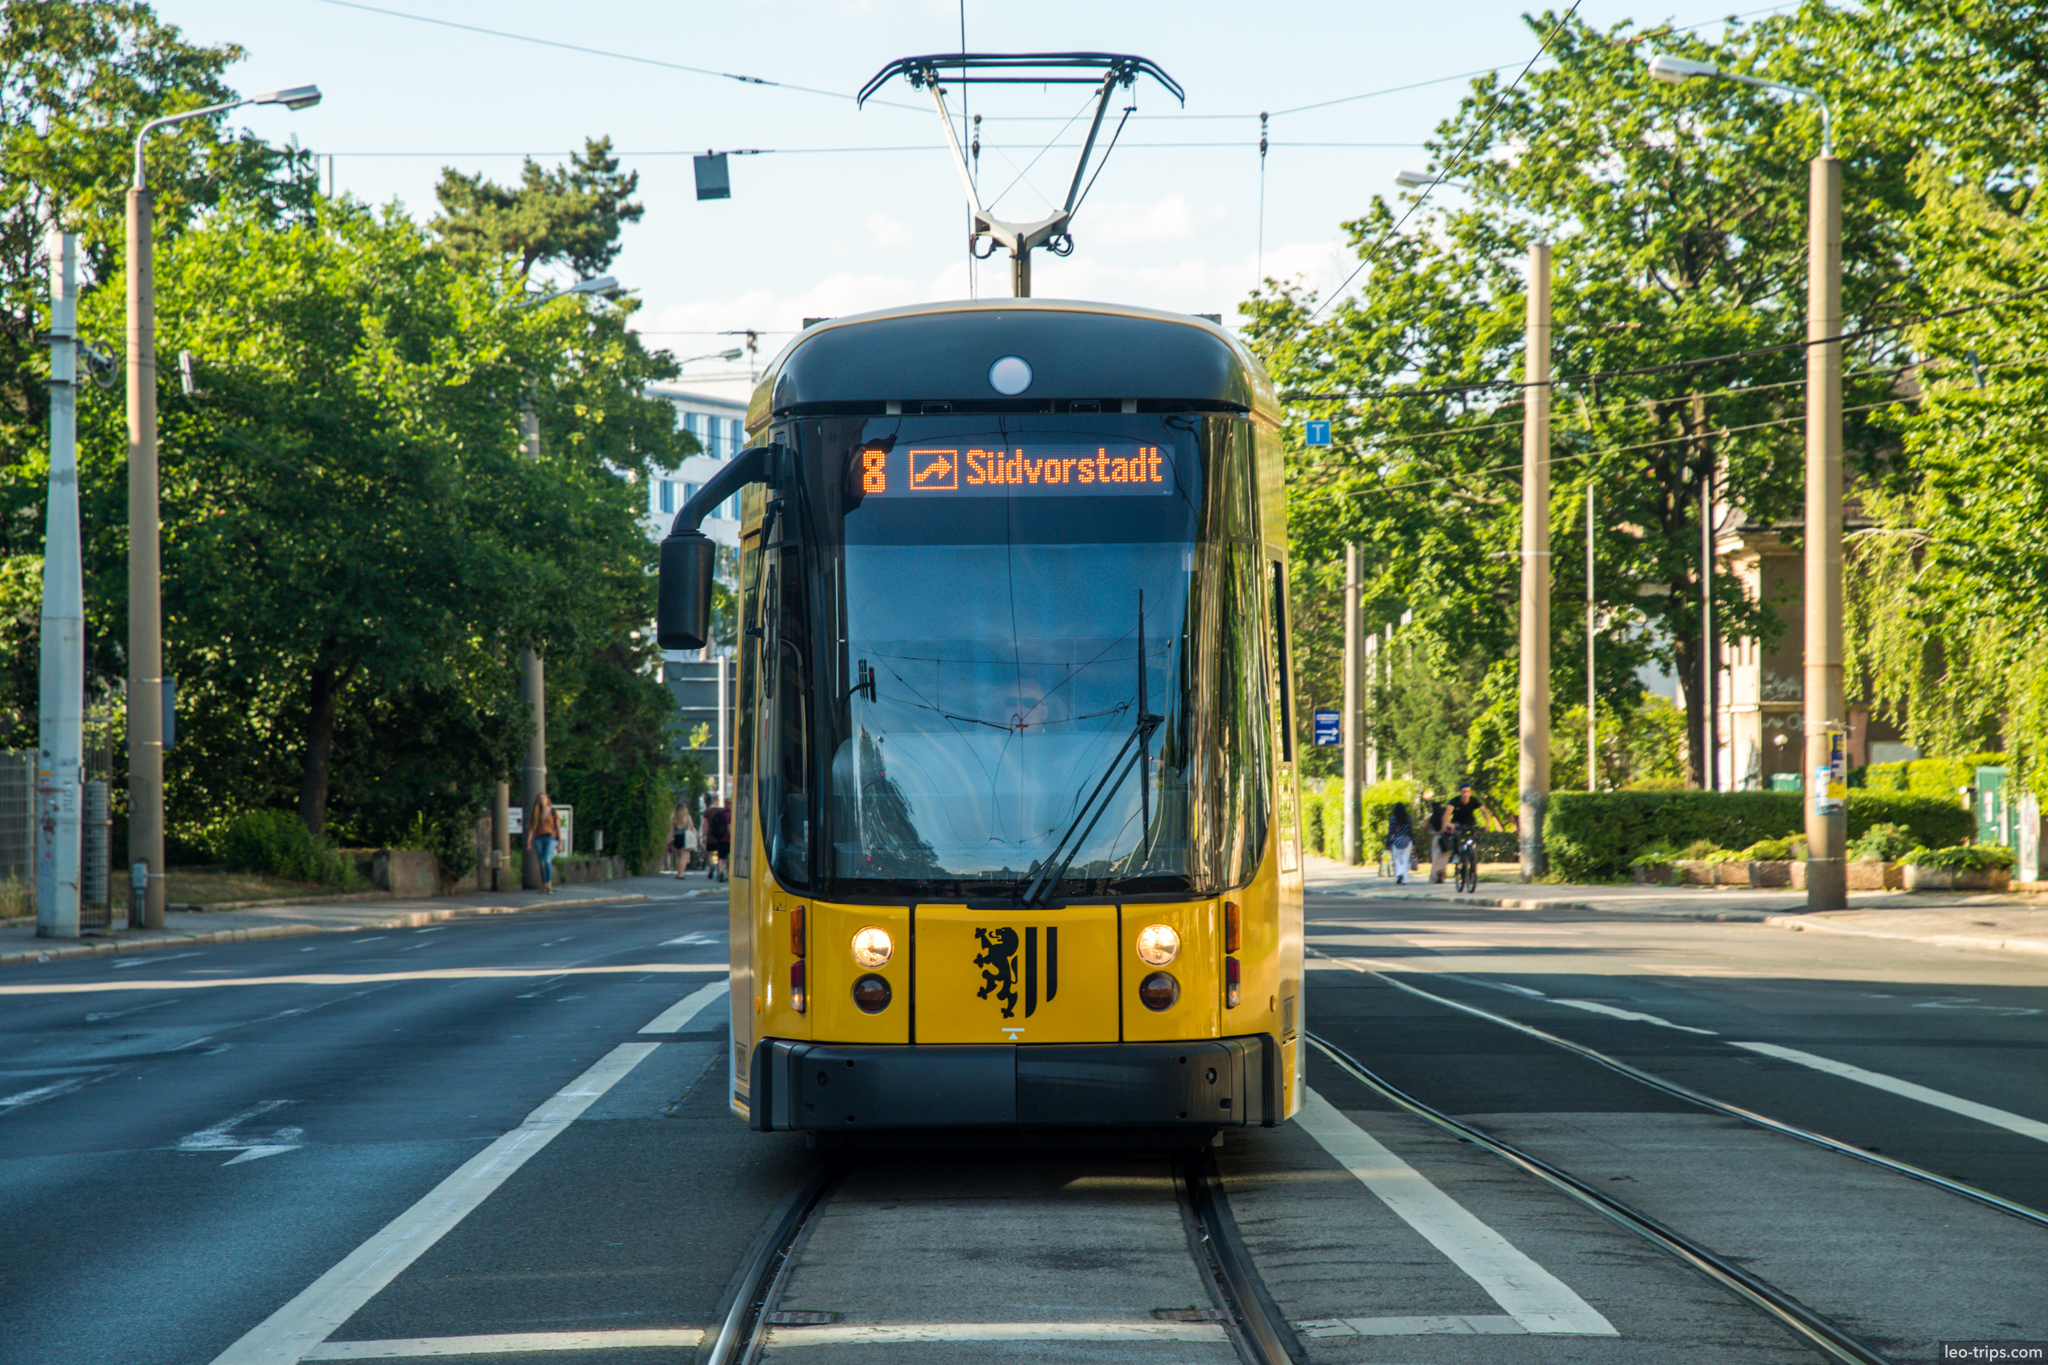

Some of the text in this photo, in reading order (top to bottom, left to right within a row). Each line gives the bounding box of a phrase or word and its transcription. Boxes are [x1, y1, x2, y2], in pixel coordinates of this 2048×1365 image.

[1311, 424, 1325, 442] T
[863, 447, 1162, 493] 8 Südvorstadt
